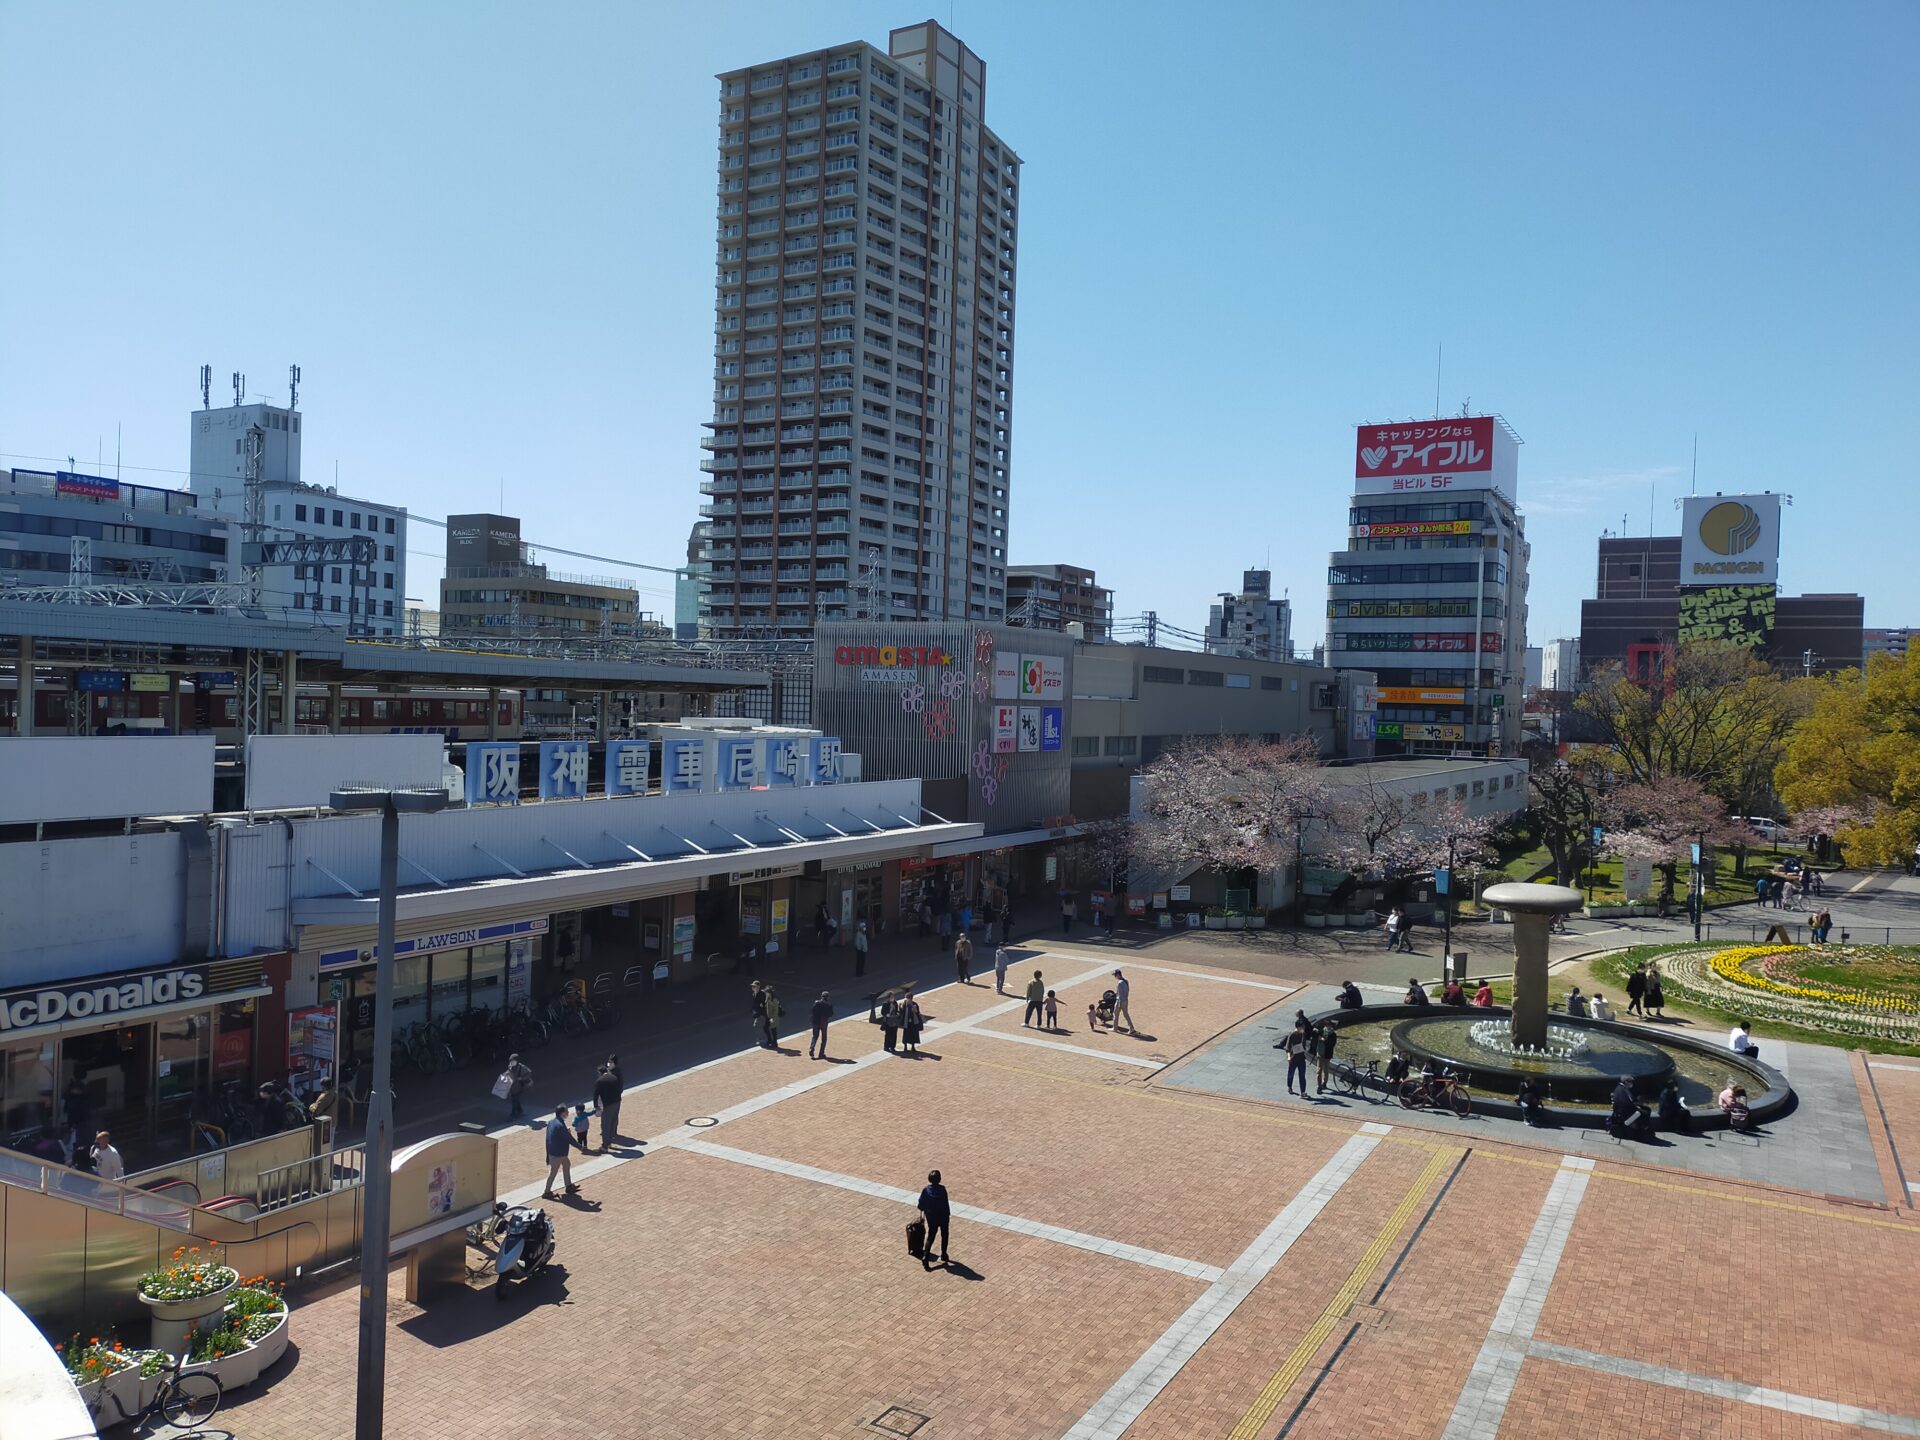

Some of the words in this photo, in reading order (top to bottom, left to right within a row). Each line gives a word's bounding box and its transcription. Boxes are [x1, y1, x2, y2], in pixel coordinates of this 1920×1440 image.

[1377, 427, 1472, 442] キャッシングなら
[1391, 440, 1484, 469] アイフル
[1393, 478, 1425, 490] 当ビル
[1431, 475, 1453, 488] 5F
[452, 529, 481, 537] KAMEDA
[490, 530, 517, 540] KAMEDA
[1693, 561, 1765, 575] PACHIGIN
[1351, 639, 1411, 649] あらいクリニック
[1426, 639, 1465, 650] アイフル
[862, 671, 916, 681] AMASEN
[417, 930, 477, 951] LAWSON
